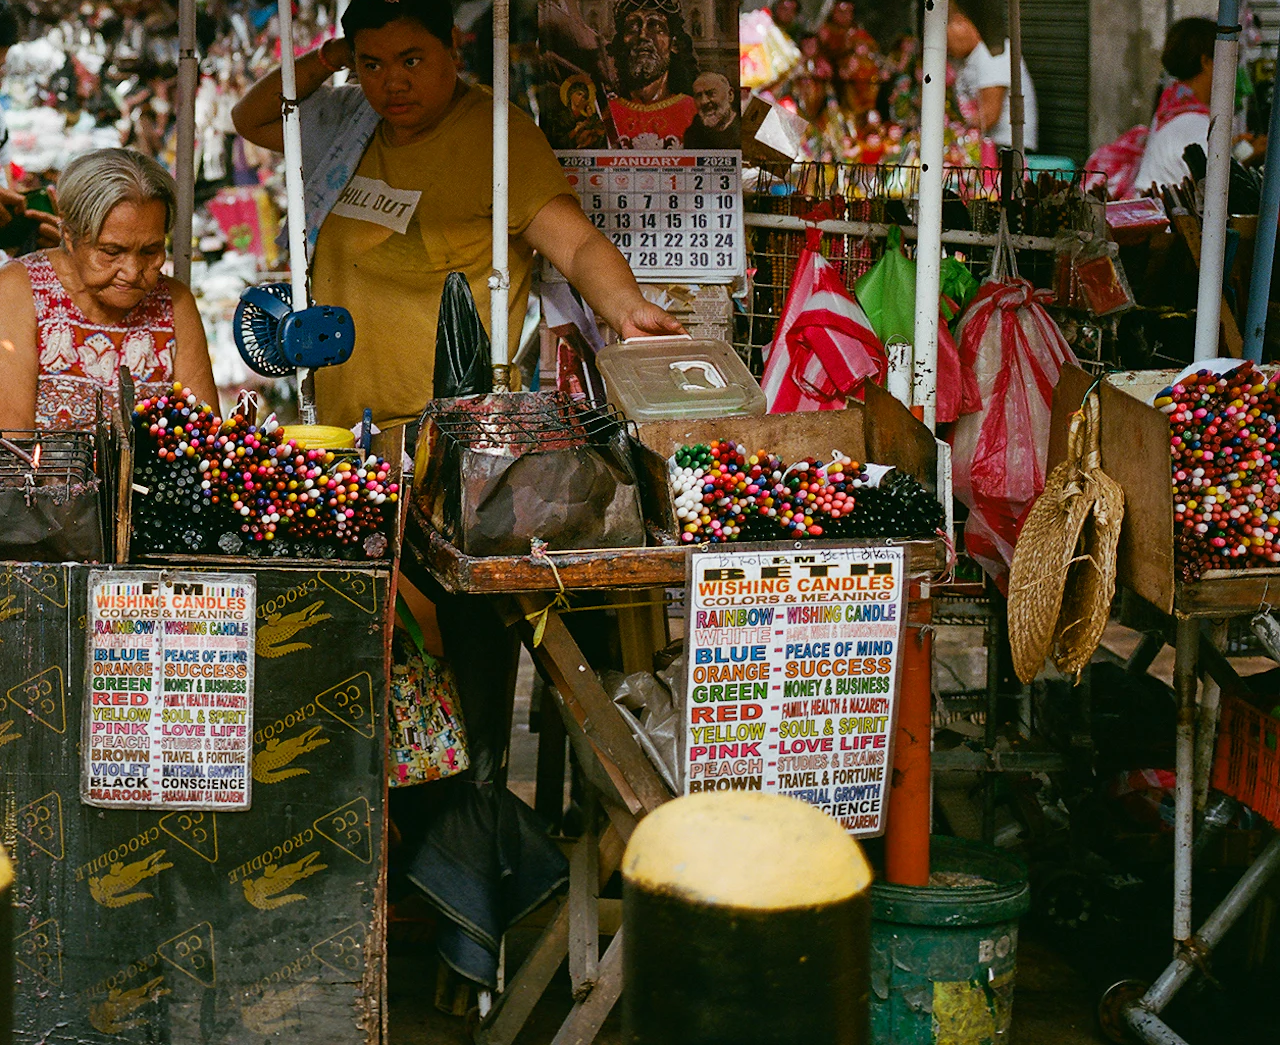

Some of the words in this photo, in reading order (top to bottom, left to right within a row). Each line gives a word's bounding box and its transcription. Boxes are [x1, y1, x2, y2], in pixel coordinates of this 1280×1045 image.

[564, 157, 592, 166] 2026
[609, 157, 681, 166] JANUARY
[704, 157, 732, 166] 2026
[670, 175, 677, 190] 1
[694, 175, 703, 190] 2
[720, 175, 730, 190] 3
[337, 186, 371, 208] HILL
[372, 194, 411, 218] OUT
[592, 195, 602, 209] 5
[617, 195, 627, 209] 6
[643, 195, 652, 209] 7
[668, 195, 678, 209] 8
[694, 195, 704, 209] 9
[716, 195, 733, 209] 10
[589, 214, 605, 228] 12
[615, 214, 631, 228] 13
[639, 214, 656, 228] 14
[665, 214, 682, 228] 15
[691, 214, 707, 228] 16
[717, 214, 732, 228] 17
[612, 233, 631, 247] 20
[640, 233, 657, 247] 21
[664, 233, 683, 247] 22
[690, 233, 709, 247] 23
[715, 233, 733, 247] 24
[639, 252, 657, 266] 28
[665, 252, 683, 266] 29
[690, 252, 709, 266] 30
[717, 252, 733, 266] 31
[704, 563, 892, 581] BETH
[699, 579, 790, 596] WISHING
[798, 576, 894, 592] CANDLES
[97, 595, 166, 608] WISHING
[172, 595, 246, 610] CANDLES
[256, 578, 317, 619] CROCOD
[703, 594, 779, 607] COLORS
[784, 594, 796, 602] &
[802, 592, 891, 602] MEANING
[100, 609, 159, 617] COLORS
[162, 609, 172, 617] &
[176, 610, 244, 619] MEANING
[697, 608, 774, 629] RAINBOW
[787, 606, 841, 624] WISHING
[845, 604, 896, 622] CANDLE
[695, 645, 766, 665] BLUE
[786, 643, 830, 659] PEACE
[834, 642, 852, 657] OF
[857, 641, 893, 656] MIND
[93, 662, 153, 676] ORANGE
[165, 664, 247, 679] SUCCESS
[694, 663, 770, 684] ORANGE
[785, 658, 891, 678] SUCCESS
[693, 682, 768, 703] GREEN
[784, 679, 821, 698] MONEY
[824, 678, 832, 695] &
[836, 677, 890, 695] BUSINESS
[92, 708, 151, 722] YELLOW
[162, 709, 193, 723] SOUL
[197, 710, 205, 723] &
[209, 710, 246, 724] SPIRIT
[691, 704, 763, 723] RED
[92, 722, 148, 735] PINK
[162, 725, 205, 736] LOVE
[211, 725, 246, 737] LIFE
[254, 703, 316, 744] CROCOD
[691, 722, 766, 744] YELLOW
[779, 720, 818, 738] SOUL
[823, 719, 834, 735] &
[839, 716, 888, 735] SPIRIT
[690, 742, 761, 761] PINK
[779, 738, 833, 754] LOVE
[840, 735, 886, 750] LIFE
[91, 778, 148, 788] BLACK
[162, 778, 244, 789] CONSCIENCE
[690, 776, 762, 794] BROWN
[778, 772, 819, 789] TRAVEL
[822, 771, 829, 785] &
[833, 768, 883, 784] FORTUNE
[74, 826, 160, 883] CROCODILE
[227, 828, 314, 885] CROCODILE
